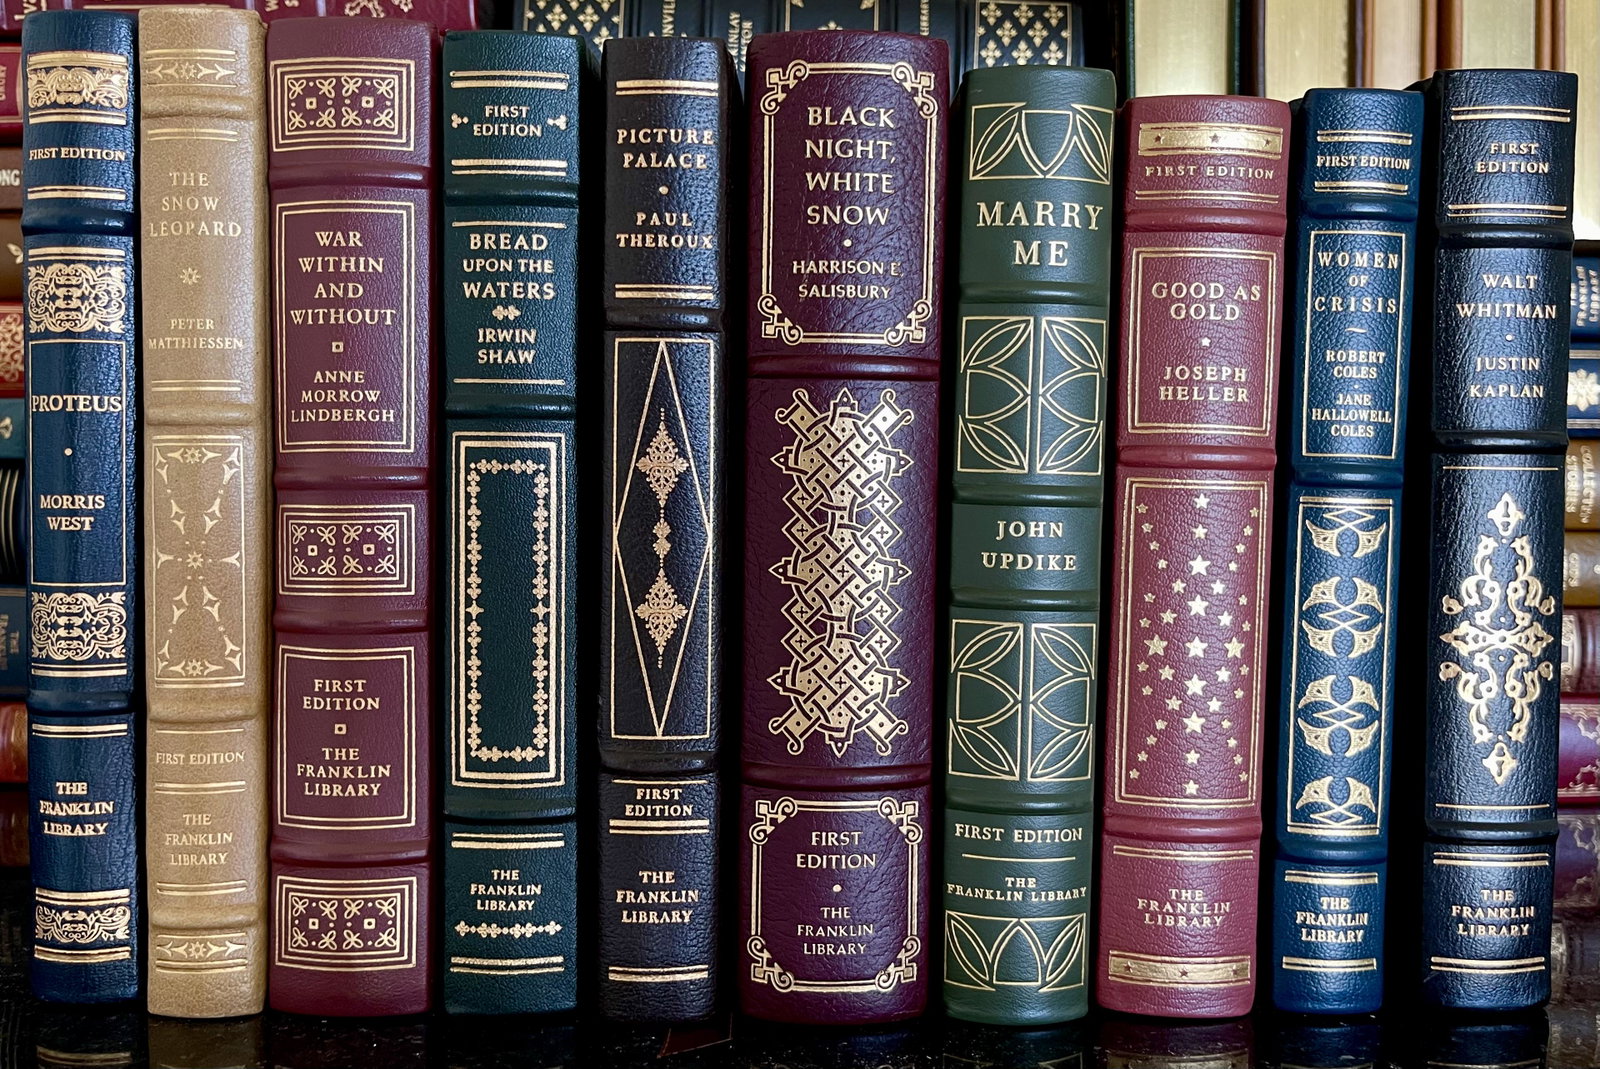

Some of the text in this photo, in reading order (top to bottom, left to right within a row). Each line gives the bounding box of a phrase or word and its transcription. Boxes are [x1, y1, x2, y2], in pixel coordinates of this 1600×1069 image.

[484, 106, 530, 118] FIRST
[808, 106, 895, 128] BLACK
[473, 123, 542, 137] EDITION
[616, 128, 714, 146] PICTURE
[29, 147, 126, 162] FIRST EDITION
[804, 139, 896, 163] NIGHT,
[1490, 142, 1540, 156] FIRST
[623, 152, 707, 169] PALACE
[1316, 155, 1411, 170] FIRST EDITION
[1476, 159, 1550, 174] EDITION
[0, 169, 20, 187] NG
[169, 172, 209, 187] THE
[1145, 164, 1275, 180] FIRST EDITION
[806, 172, 895, 194] WHITE
[161, 196, 220, 212] SNOW
[636, 212, 692, 227] PAUL
[806, 206, 890, 226] SNOW
[976, 201, 1104, 232] MARRY
[149, 221, 242, 238] LEOPARD
[315, 230, 363, 247] WAR
[468, 234, 548, 250] BREAD
[616, 233, 714, 250] THEROUX
[1013, 240, 1069, 267] ME
[1318, 250, 1400, 270] WOMEN
[298, 256, 384, 274] WITHIN
[462, 258, 554, 274] UPON THE
[792, 260, 884, 275] HARRISON
[1348, 276, 1369, 288] OF
[1482, 274, 1538, 290] WALT
[314, 282, 364, 299] AND
[462, 282, 556, 300] WATERS
[798, 284, 891, 299] SALISBURY
[1151, 282, 1262, 302] GOOD AS
[1170, 302, 1241, 322] GOLD
[1314, 296, 1398, 315] CRISIS
[1456, 302, 1557, 322] WHITMAN
[170, 318, 214, 331] PETER
[290, 308, 396, 326] WITHOUT
[148, 337, 244, 351] MATTHIESSEN
[477, 328, 536, 345] IRWIN
[477, 348, 536, 365] SHAW
[1326, 350, 1386, 364] ROBERT
[1475, 356, 1541, 372] JUSTIN
[314, 370, 365, 384] ANNE
[1164, 364, 1248, 384] JOSEPH
[1333, 366, 1378, 379] COLES
[300, 388, 382, 404] MORROW
[1159, 384, 1250, 402] HELLER
[1469, 383, 1544, 398] KAPLAN
[32, 394, 122, 414] PROTEUS
[1336, 394, 1372, 406] JANE
[290, 407, 395, 424] LINDBERGH
[1312, 408, 1392, 423] HALLOWELL
[1331, 424, 1374, 438] COLES
[1566, 454, 1580, 513] STORIES
[40, 494, 106, 510] MORRIS
[46, 516, 94, 532] WEST
[996, 520, 1064, 540] JOHN
[980, 551, 1077, 572] UPDIKE
[314, 678, 366, 693] FIRST
[302, 696, 380, 711] EDITION
[156, 750, 245, 765] FIRST EDITION
[322, 748, 360, 761] THE
[296, 764, 392, 778] FRANKLIN
[56, 782, 88, 795] THE
[304, 782, 382, 797] LIBRARY
[636, 788, 682, 801] FIRST
[39, 800, 114, 816] FRANKLIN
[624, 803, 693, 818] EDITION
[182, 813, 212, 826] THE
[44, 821, 108, 836] LIBRARY
[954, 824, 1083, 844] FIRST EDITION
[164, 831, 233, 846] FRANKLIN
[810, 830, 864, 846] FIRST
[170, 852, 228, 866] LIBRARY
[796, 852, 876, 870] EDITION
[491, 869, 520, 880] THE
[638, 871, 676, 884] THE
[470, 884, 542, 896] FRANKLIN
[1004, 877, 1037, 889] THE
[616, 888, 699, 904] FRANKLIN
[946, 882, 1088, 901] FRANKLIN LIBRARY
[1168, 889, 1205, 902] THE
[1480, 889, 1515, 902] THE
[476, 899, 535, 912] LIBRARY
[1136, 899, 1232, 916] FRANKLIN
[1320, 896, 1350, 912] THE
[621, 908, 694, 924] LIBRARY
[820, 906, 852, 919] THE
[1143, 912, 1224, 929] LIBRARY
[1295, 911, 1369, 928] FRANKLIN
[1452, 906, 1536, 920] FRANKLIN
[796, 924, 875, 938] FRANKLIN
[1301, 928, 1365, 944] LIBRARY
[1458, 922, 1530, 938] LIBRARY
[803, 942, 868, 956] LIBRARY
